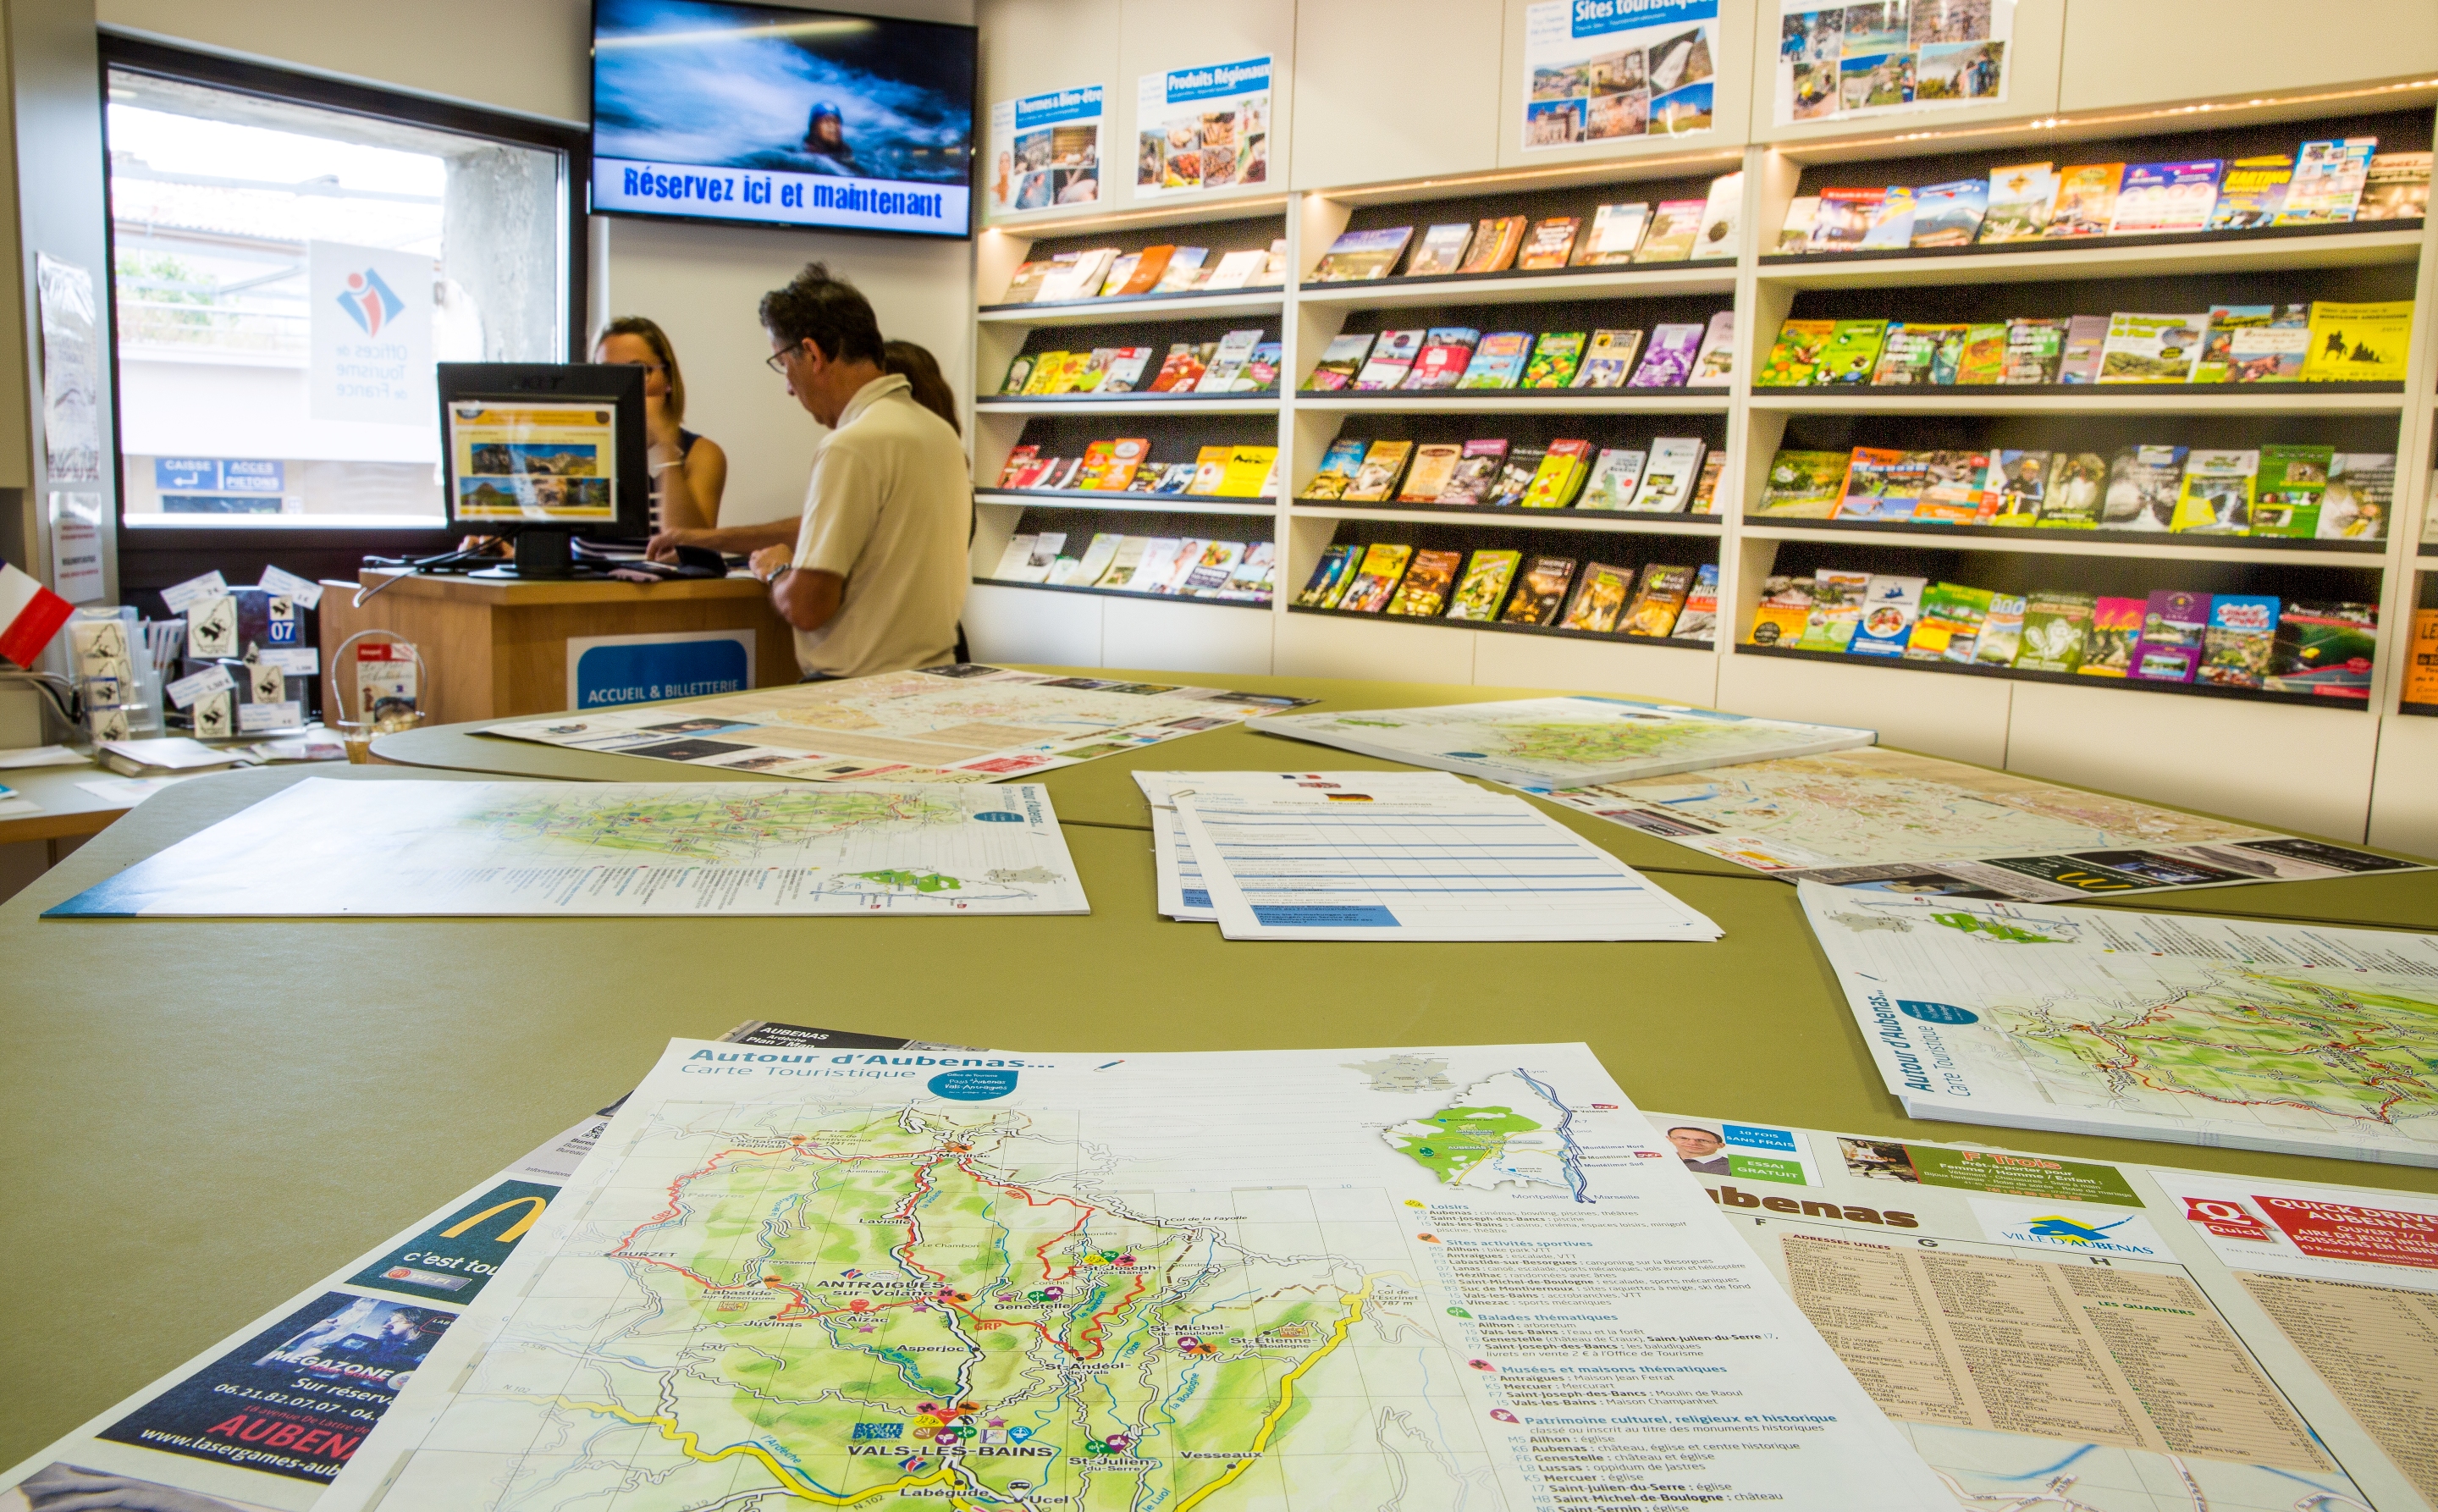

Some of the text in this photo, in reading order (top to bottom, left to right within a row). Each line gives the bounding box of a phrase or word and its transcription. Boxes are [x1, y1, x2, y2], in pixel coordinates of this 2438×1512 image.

[1575, 0, 1613, 21] Sites
[1168, 63, 1271, 91] Produits Régionaux
[1018, 97, 1051, 114] Thermes
[1059, 87, 1102, 108] Bien-être
[624, 167, 942, 218] Réservez ici et maintenant
[165, 460, 211, 472] CAISSE
[230, 462, 273, 474] ACCES
[226, 476, 279, 488] PIETONS
[271, 622, 295, 640] 07
[587, 680, 738, 703] ACCUEIL & BILLETTERIE
[760, 1028, 829, 1040] AUBENAS
[1867, 990, 1934, 1092] Autour d'Aubenas...
[689, 1049, 1055, 1068] Autour d'Aubenas...
[1918, 1026, 1971, 1096] Carte Touristique
[681, 1064, 916, 1079] Carte Touristique
[1758, 1140, 1795, 1148] FRAIS
[1747, 1161, 1784, 1169] ESSAI
[1962, 1151, 2062, 1170] F Trois
[1737, 1166, 1798, 1178] GRATUIT
[1962, 1160, 2072, 1178] Prêt-à-porter pour
[2269, 1198, 2438, 1224] QUICK DRIVE
[2308, 1211, 2435, 1232] AUBENAS
[2209, 1224, 2263, 1237] Quick
[2298, 1228, 2331, 1238] AIRE
[2336, 1232, 2354, 1240] DE
[2355, 1233, 2396, 1245] JEUX
[2336, 1225, 2426, 1240] OUVERT 7/7
[1792, 1233, 1891, 1250] ADRESSES UTILES
[2001, 1231, 2154, 1255] VILLE D'AUBENAS
[2292, 1234, 2372, 1248] BOISSONS
[403, 1251, 464, 1270] c'est
[2314, 1246, 2348, 1255] Route
[2369, 1252, 2433, 1263] Montélimar
[411, 1272, 450, 1285] WI-FI
[817, 1280, 953, 1289] ANTRAIGUES-
[2253, 1273, 2292, 1282] VOIES
[2314, 1280, 2434, 1297] COMMUNICATION
[832, 1289, 933, 1298] sur-Volane
[2122, 1303, 2196, 1316] QUARTIERS
[1534, 1313, 1618, 1322] thématiques
[974, 1322, 1002, 1332] GRP
[1231, 1337, 1318, 1345] St-Etienne-
[896, 1344, 964, 1354] Asperjoc
[271, 1350, 395, 1381] MEGAZONE
[1045, 1362, 1131, 1371] St-Andéol-
[1639, 1365, 1728, 1374] thématiques
[291, 1377, 333, 1392] Sur
[213, 1382, 342, 1413] 06.21.82.07.07
[1525, 1415, 1607, 1424] Patrimoine
[1611, 1414, 1672, 1424] culturel,
[1675, 1415, 1740, 1424] religieux
[1763, 1414, 1838, 1423] historique
[1762, 1424, 1825, 1432] historiques
[759, 1434, 803, 1465] l'Ardèche
[847, 1445, 1053, 1458] VALS-LES-BAINS
[1068, 1458, 1157, 1466] St-Julien-
[900, 1487, 989, 1498] Labégude
[1029, 1495, 1069, 1505] Ucel
